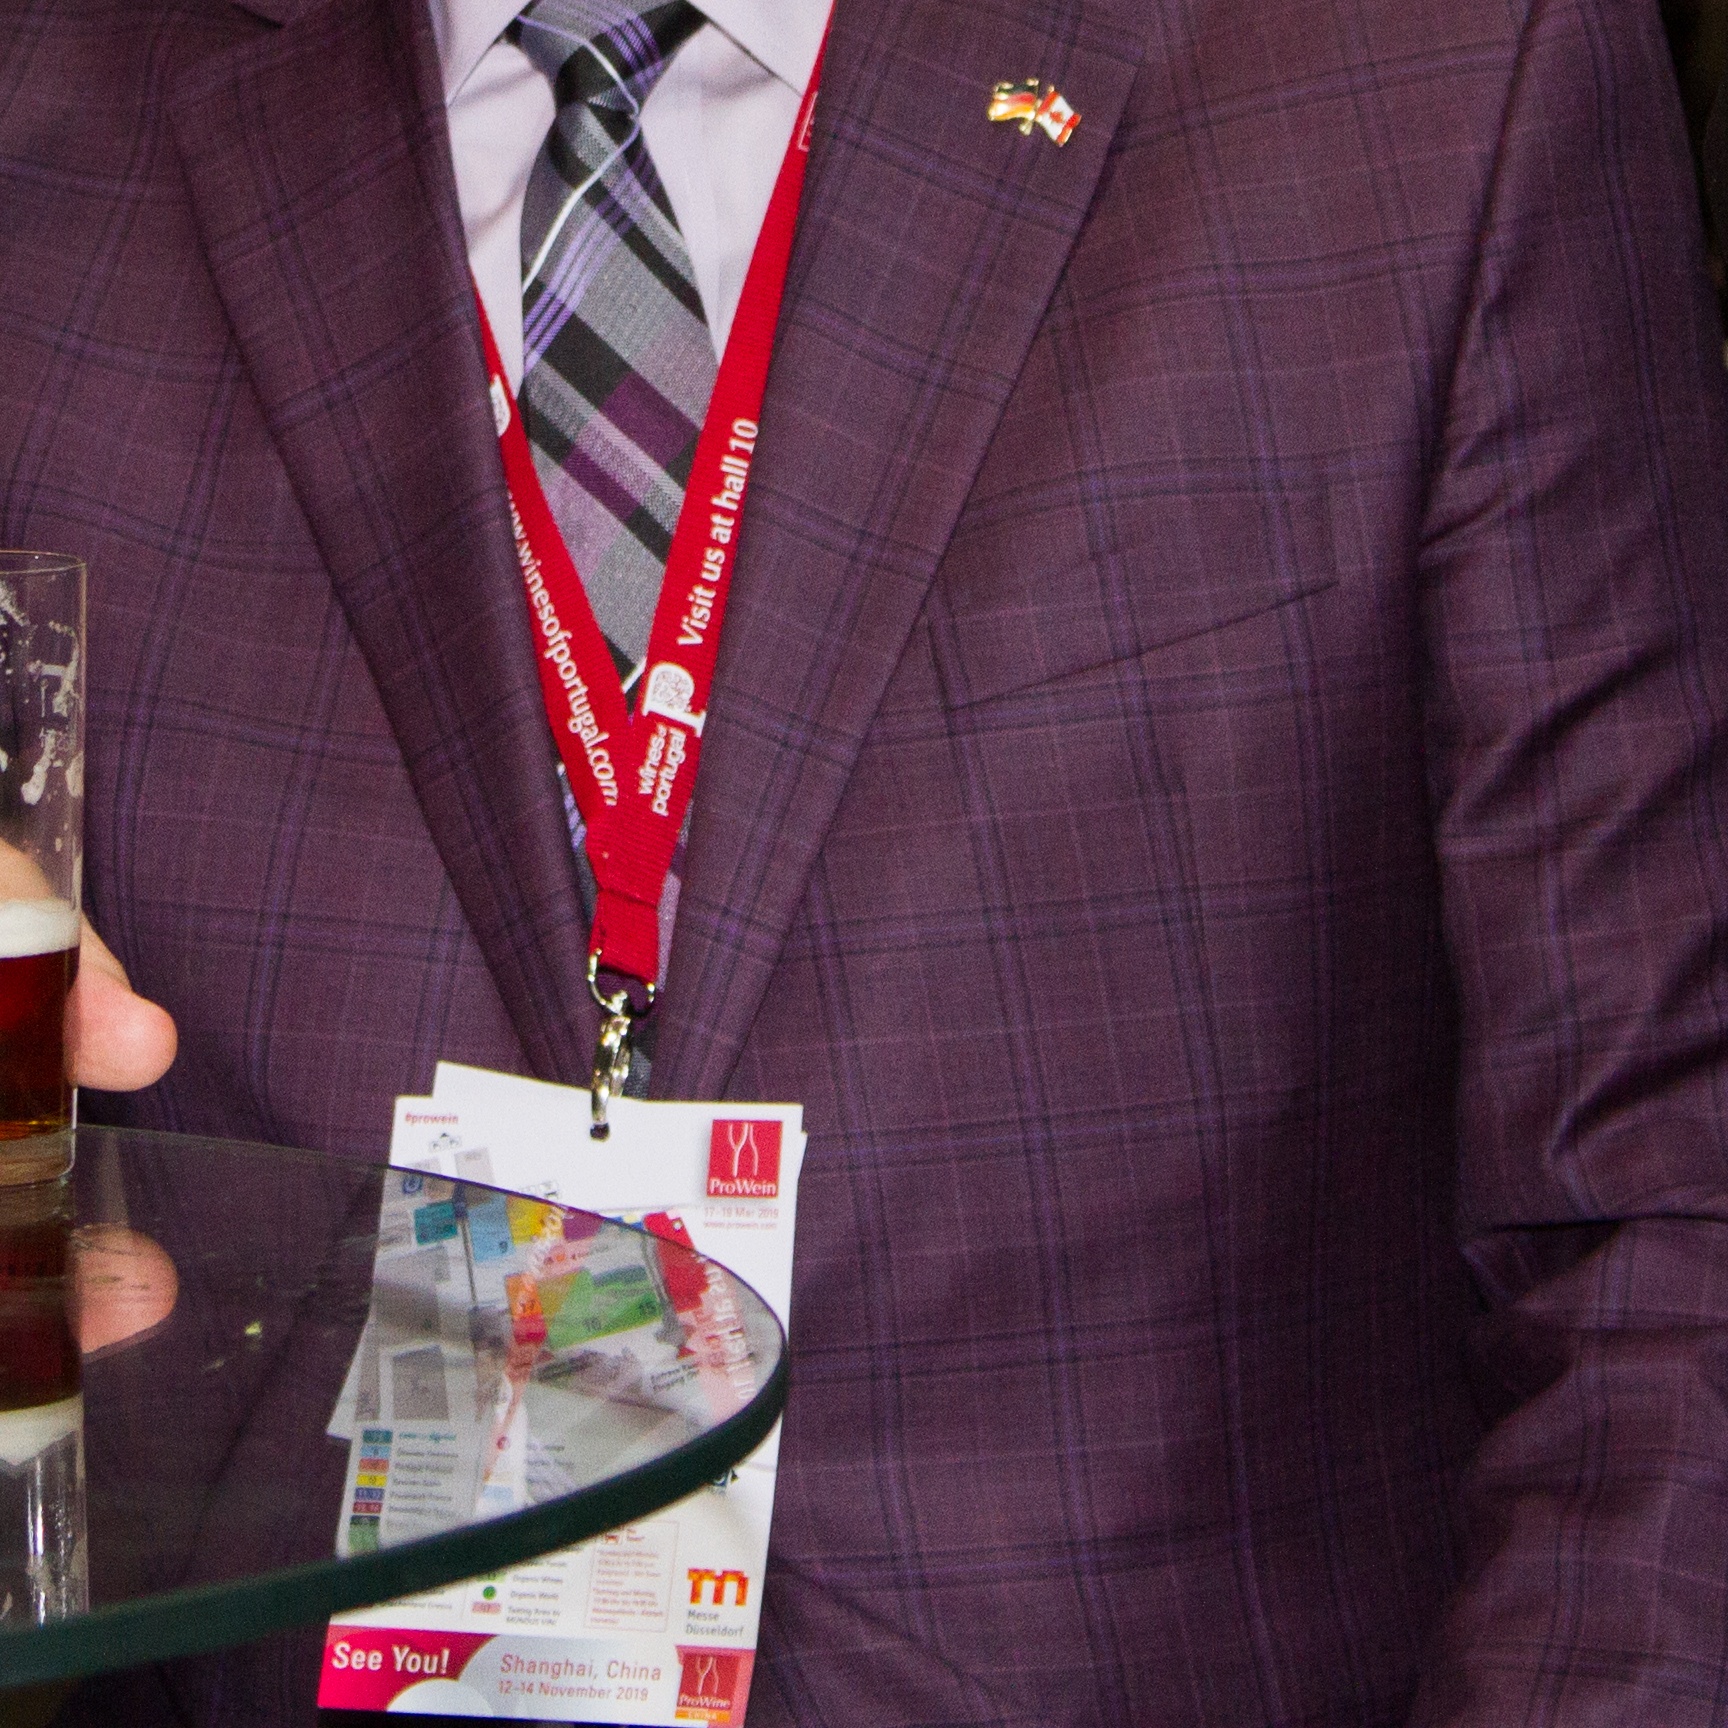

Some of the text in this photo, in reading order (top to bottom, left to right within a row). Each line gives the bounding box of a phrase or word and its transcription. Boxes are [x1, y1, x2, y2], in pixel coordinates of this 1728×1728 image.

[676, 418, 759, 646] Visit us at hall 10
[638, 734, 666, 795] wines
[651, 726, 687, 817] portugal
[709, 1177, 777, 1196] ProWein
[686, 1609, 720, 1622] Messe
[684, 1622, 745, 1638] Düsseldorf
[331, 1641, 451, 1675] See You!
[499, 1653, 662, 1682] Shanghai, China
[538, 1681, 612, 1701] November
[616, 1686, 650, 1702] 2019
[678, 1695, 732, 1710] ProWine
